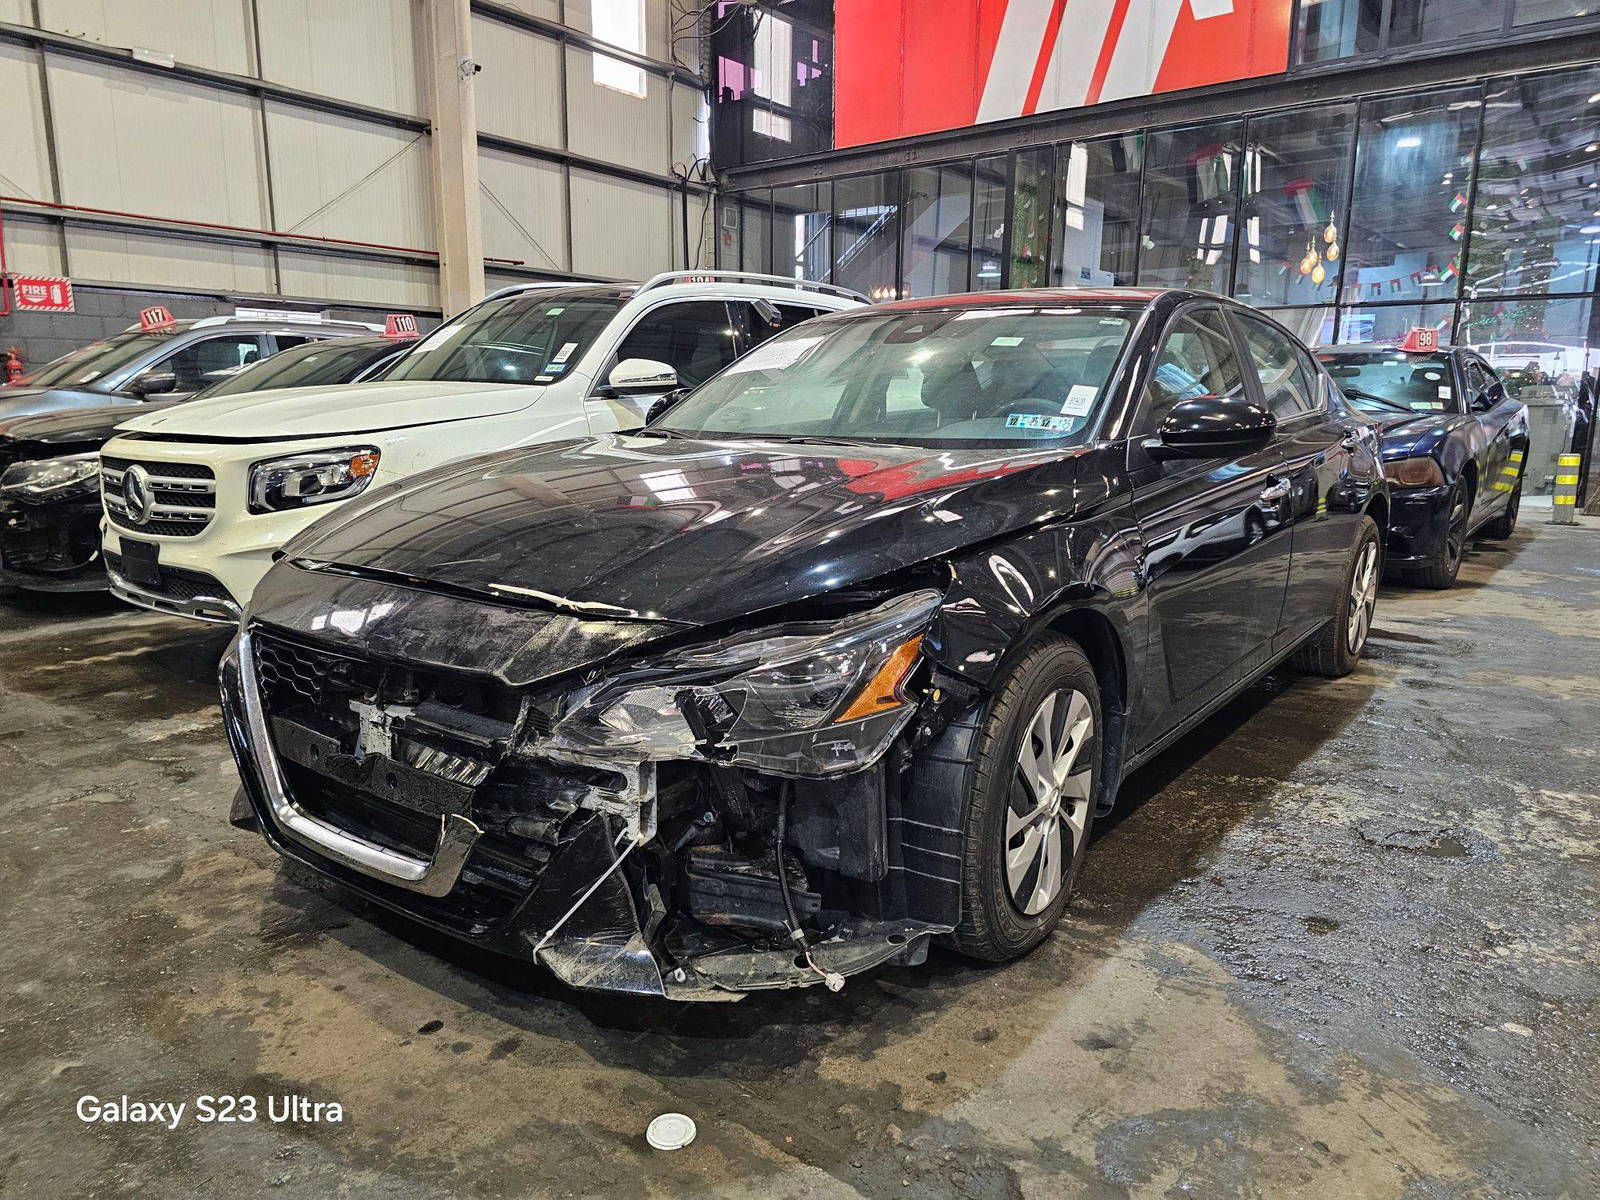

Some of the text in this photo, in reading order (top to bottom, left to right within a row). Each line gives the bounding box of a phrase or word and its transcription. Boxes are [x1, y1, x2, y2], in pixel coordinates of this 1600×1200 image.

[21, 285, 48, 296] FIRE
[146, 309, 163, 323] 117
[396, 316, 414, 331] 110
[1420, 332, 1432, 346] 98
